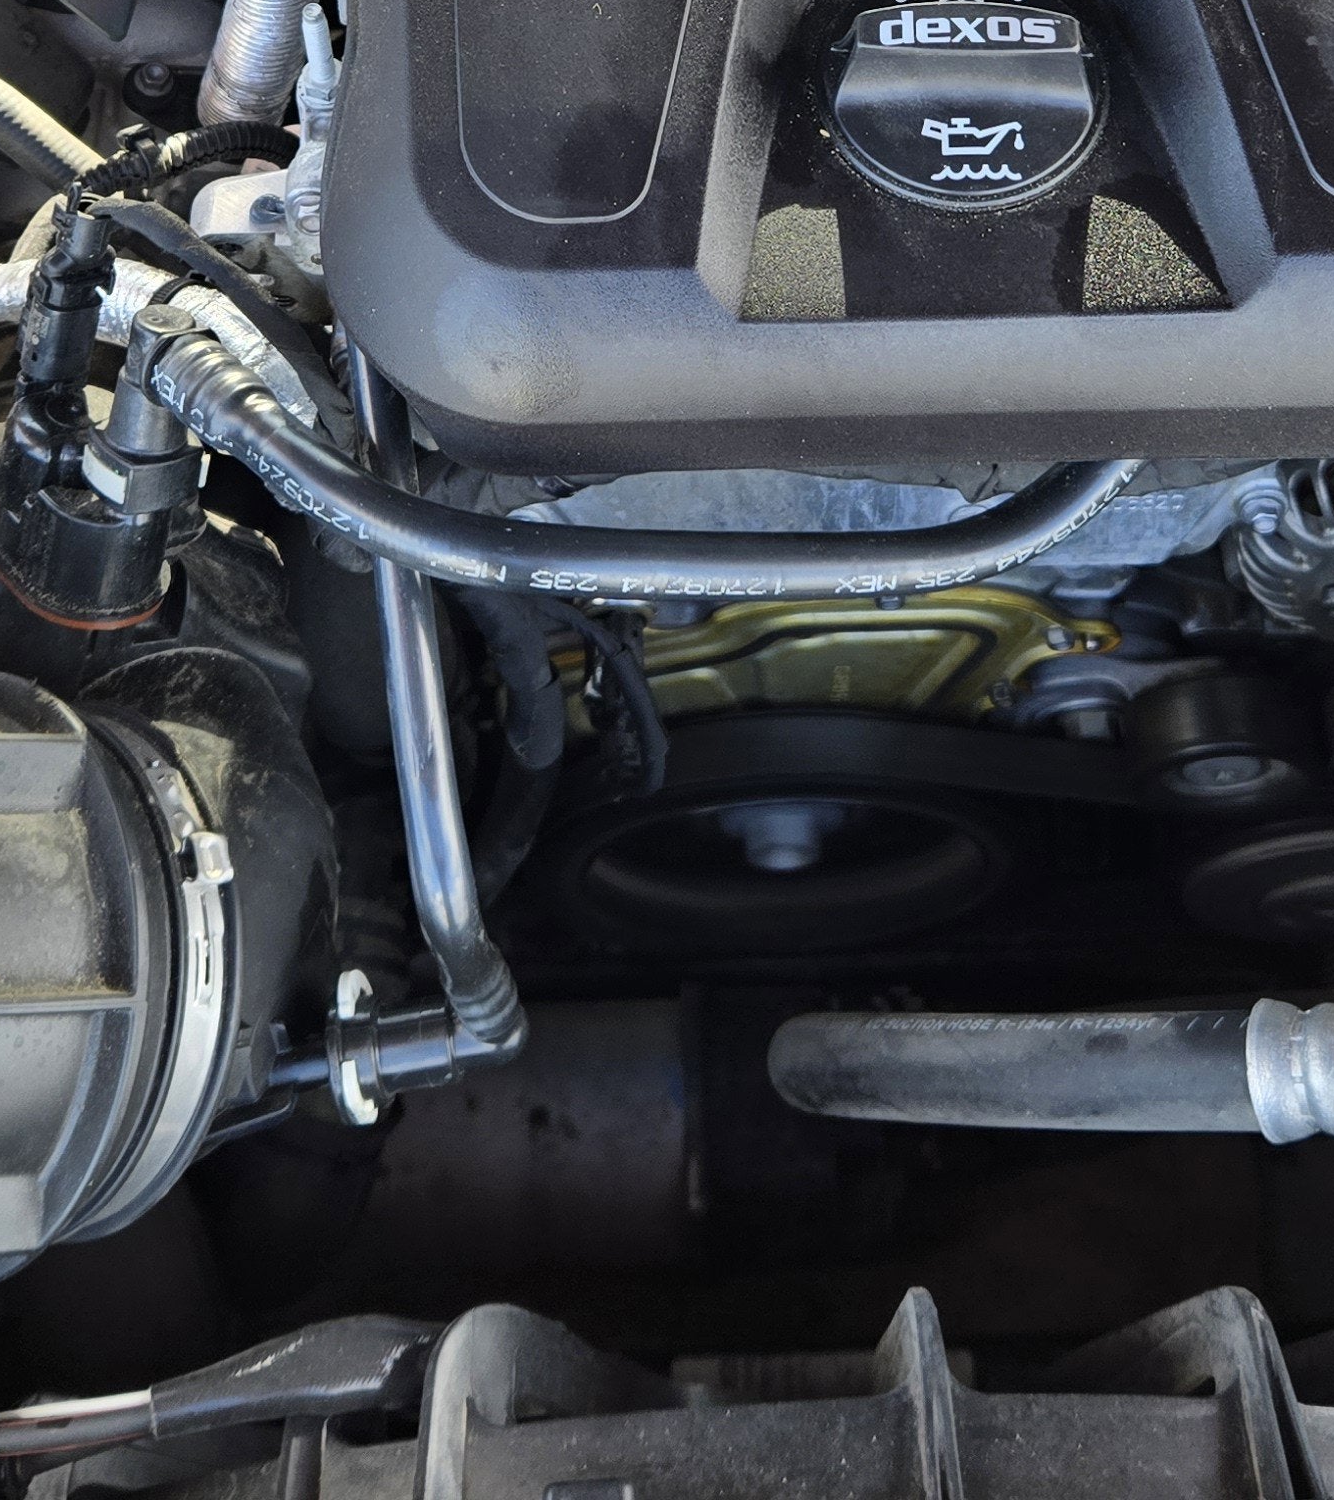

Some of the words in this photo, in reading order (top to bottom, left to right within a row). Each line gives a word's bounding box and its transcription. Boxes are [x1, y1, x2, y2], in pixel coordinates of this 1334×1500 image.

[879, 11, 1058, 46] dexos
[529, 569, 598, 593] 235
[833, 574, 898, 595] MEX
[914, 564, 977, 590] 235
[947, 1018, 995, 1031] HOSE
